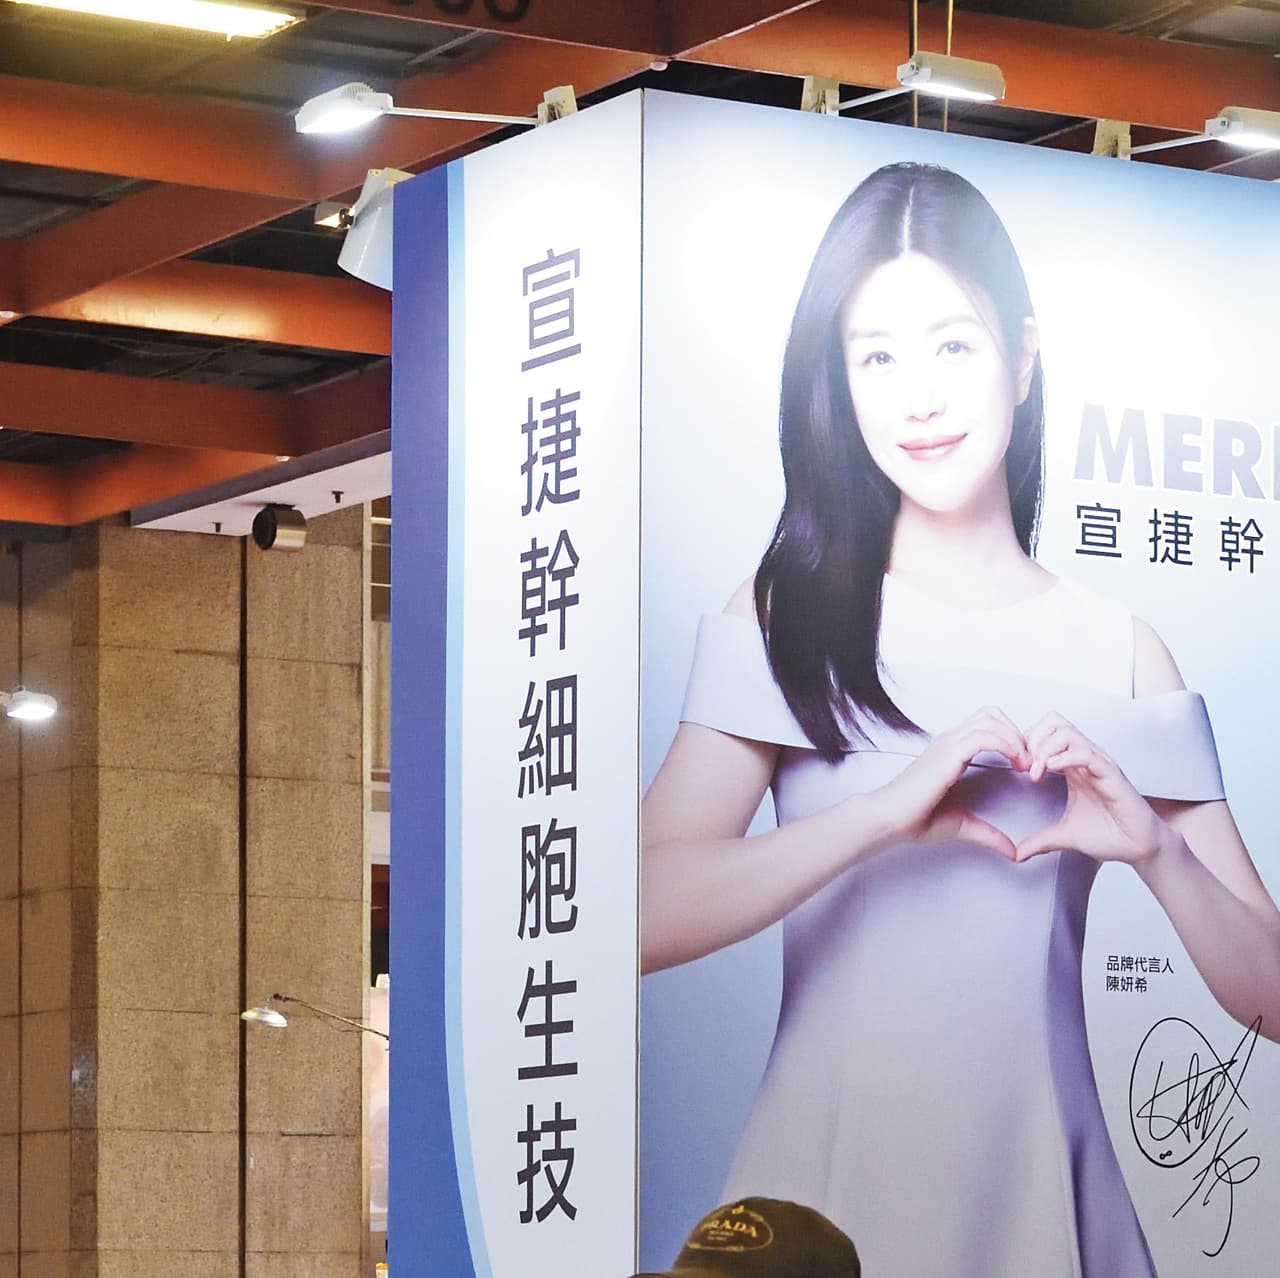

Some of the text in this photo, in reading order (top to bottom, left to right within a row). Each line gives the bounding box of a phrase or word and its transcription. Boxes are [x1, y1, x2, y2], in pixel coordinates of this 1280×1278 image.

[517, 247, 582, 1225] 宣捷幹細胞生技
[1106, 955, 1174, 974] 品牌代言人
[1106, 975, 1148, 993] 陳妍希
